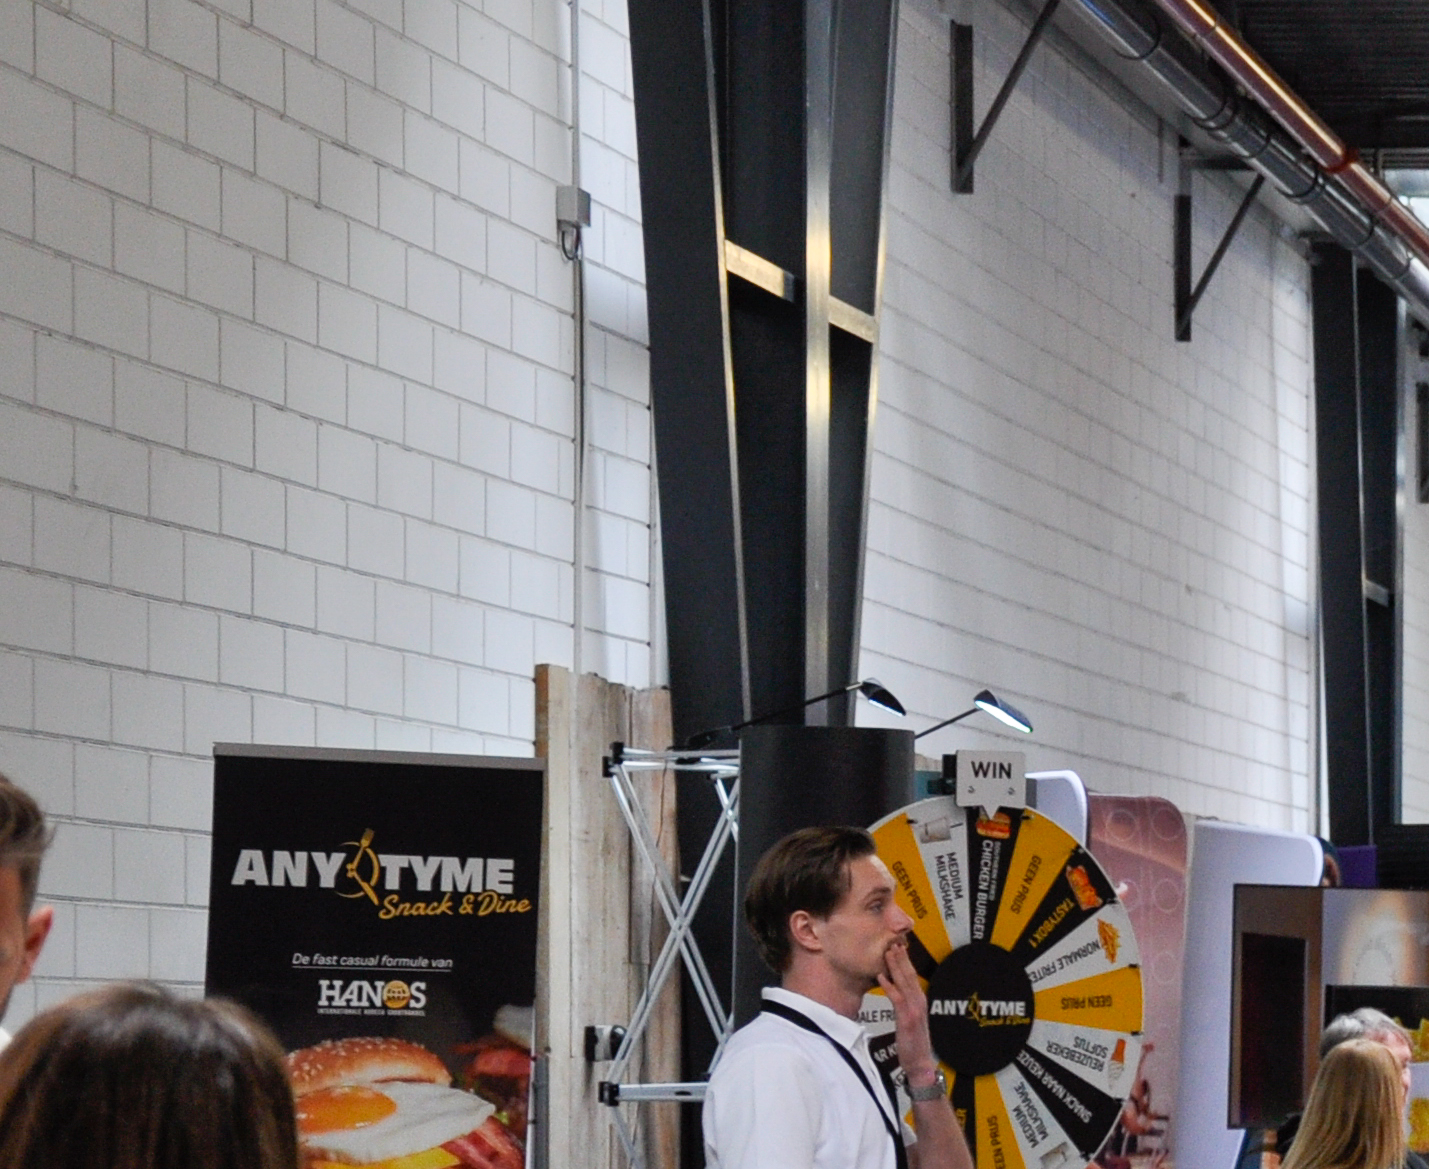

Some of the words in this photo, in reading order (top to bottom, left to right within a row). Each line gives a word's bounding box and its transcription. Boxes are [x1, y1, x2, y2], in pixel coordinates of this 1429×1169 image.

[971, 761, 1012, 779] WIN
[892, 861, 911, 892] GEEN
[946, 851, 964, 900] MEDIUM
[978, 840, 993, 892] CHICKEN
[1023, 855, 1042, 889] GEEN
[935, 854, 956, 921] MILKSHAKE
[379, 891, 454, 920] Snack
[458, 894, 474, 916] &
[477, 889, 533, 916] Dine
[973, 891, 989, 940] BURGER
[292, 953, 310, 965] De
[312, 953, 338, 966] fast
[340, 955, 379, 967] casual
[380, 954, 429, 968] formule
[431, 958, 453, 969] van
[1058, 939, 1100, 970] NORMALE
[318, 979, 427, 1009] HANOS
[1016, 1050, 1042, 1077] KEUZE
[1046, 1040, 1106, 1072] REUZEBEKER
[1041, 1073, 1068, 1098] NAAR
[1014, 1081, 1049, 1142] MILKSHAKE
[1062, 1092, 1093, 1125] SNACK
[1012, 1105, 1039, 1149] MEDIUM
